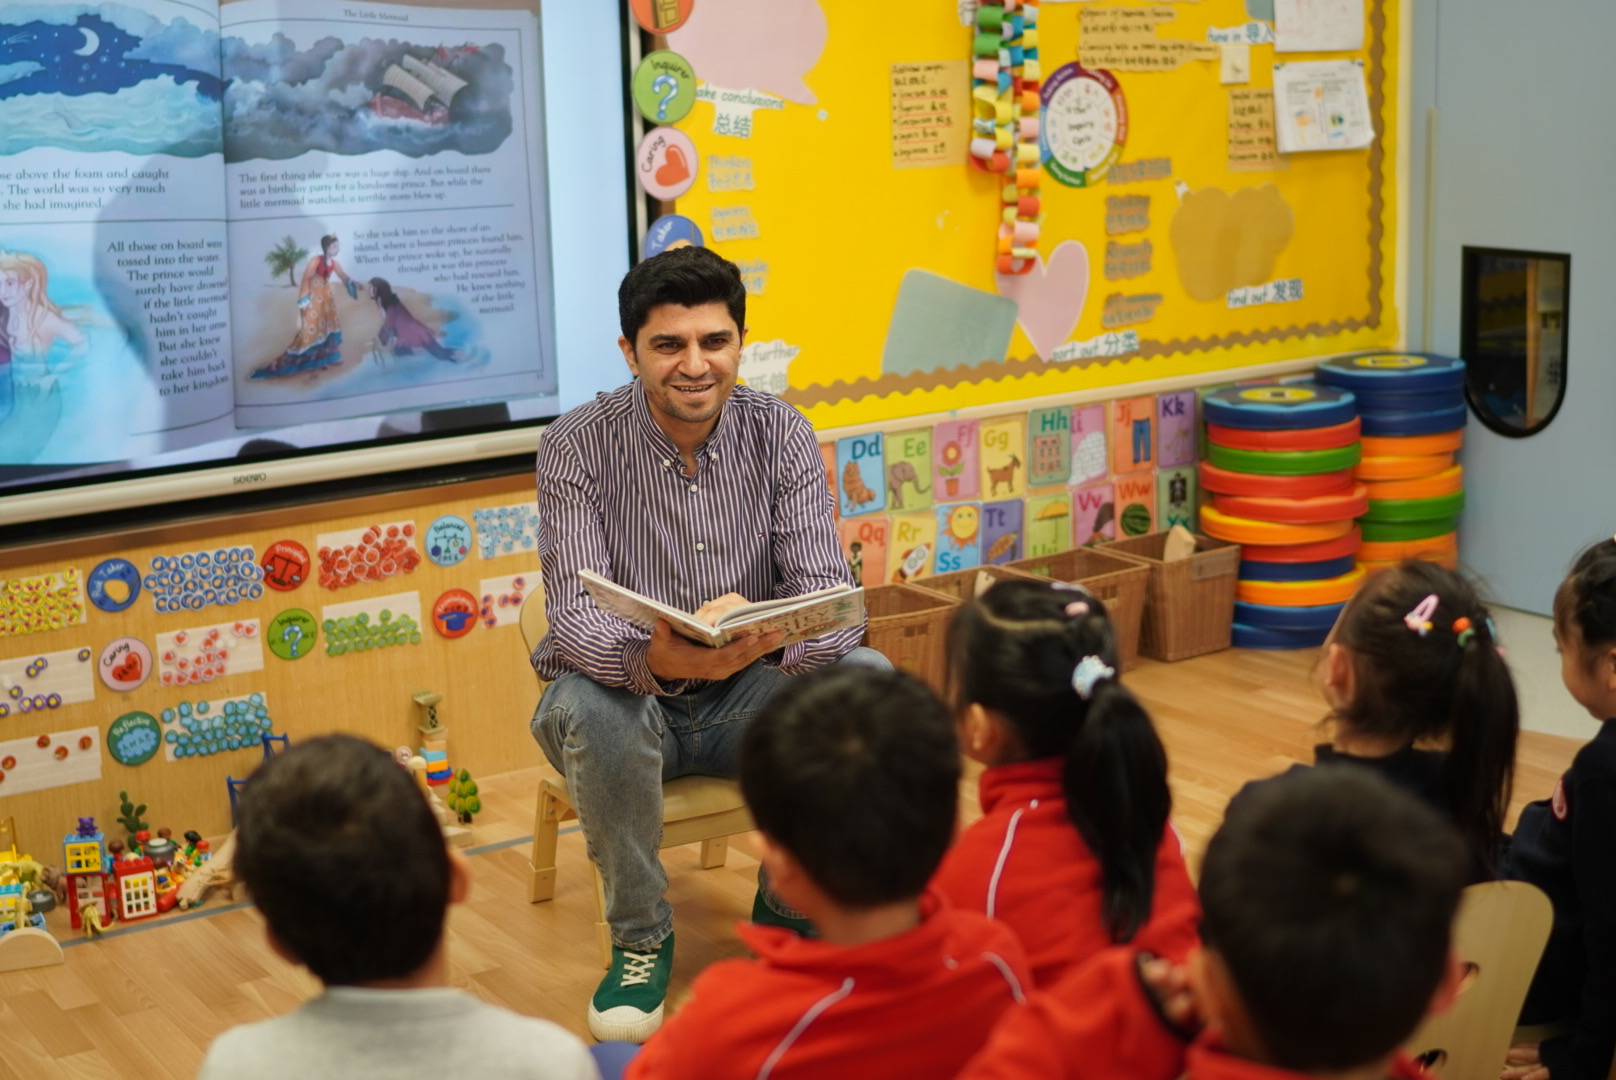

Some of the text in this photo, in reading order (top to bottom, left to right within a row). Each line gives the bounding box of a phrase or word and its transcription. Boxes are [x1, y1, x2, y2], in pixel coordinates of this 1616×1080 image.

[650, 58, 690, 80] Inquirer
[721, 87, 785, 109] conclusions
[715, 112, 752, 138] 总结
[1067, 120, 1094, 132] Inquiry
[1072, 135, 1092, 146] Cycle
[641, 136, 667, 174] Caring
[15, 168, 169, 180] above the foam and caught
[240, 172, 258, 183] The
[260, 172, 278, 182] first
[280, 171, 306, 182] thing
[308, 170, 322, 179] she
[370, 168, 390, 178] huge
[414, 168, 432, 176] And
[446, 166, 470, 174] board
[471, 166, 492, 174] there
[7, 184, 30, 195] The
[34, 184, 64, 194] world
[108, 186, 132, 196] very
[135, 182, 166, 193] much
[268, 183, 307, 195] birthday
[310, 184, 332, 193] party
[335, 182, 347, 190] for
[357, 180, 398, 190] handsome
[430, 178, 444, 187] But
[447, 177, 467, 186] while
[470, 176, 482, 185] the
[3, 198, 105, 212] she had imagined.
[240, 190, 432, 208] little mermaid watched, terrible storm blew
[354, 230, 364, 240] So
[366, 230, 380, 239] she
[382, 228, 400, 238] took
[402, 228, 418, 237] him
[431, 226, 444, 235] the
[446, 225, 468, 234] shore
[470, 224, 480, 233] of
[652, 220, 673, 250] Taker
[107, 242, 124, 252] All
[128, 240, 157, 252] those
[177, 239, 204, 250] board
[206, 241, 223, 249] were
[354, 242, 381, 254] island,
[384, 240, 407, 250] where
[417, 238, 446, 248] human
[448, 236, 480, 248] princess
[481, 234, 504, 244] found
[117, 254, 194, 267] tossed into the
[354, 244, 512, 265] When the prince woke he naturally
[127, 266, 214, 282] The prince would
[398, 262, 430, 274] thought
[432, 261, 440, 270] it
[458, 259, 474, 268] this
[475, 258, 507, 270] princess
[434, 274, 451, 283] who
[453, 271, 469, 281] had
[472, 269, 502, 280] rescued
[136, 284, 166, 296] surely
[170, 282, 194, 294] have
[456, 280, 526, 293] He knew nothing
[1272, 278, 1303, 302] 发现
[144, 299, 153, 310] if
[154, 298, 171, 309] the
[174, 296, 196, 308] little
[471, 291, 514, 303] of the little
[1227, 287, 1268, 308] find out
[150, 308, 217, 324] hadn't caught
[155, 323, 206, 338] him in her
[158, 336, 220, 352] But she knew
[752, 340, 800, 364] further
[1052, 340, 1099, 362] sort out
[1103, 330, 1140, 356] 分类
[160, 348, 218, 368] she couldn't
[161, 360, 226, 382] take him back
[159, 374, 229, 397] to her kingdom
[1116, 404, 1132, 428] Jj
[1162, 396, 1185, 418] Kk
[1042, 410, 1068, 432] Hh
[958, 422, 977, 448] Ff
[984, 428, 1009, 452] Gg
[852, 434, 882, 460] Dd
[904, 437, 928, 459] Ee
[234, 472, 266, 484] seewo
[1118, 481, 1151, 499] Ww
[1078, 491, 1102, 512] Vv
[433, 520, 466, 532] Balanced
[986, 506, 1007, 528] Tt
[858, 522, 886, 548] Qq
[896, 521, 922, 542] Rr
[98, 562, 126, 578] Taker
[938, 551, 962, 573] Ss
[103, 642, 131, 667] Caring
[112, 716, 151, 737] Reflective
